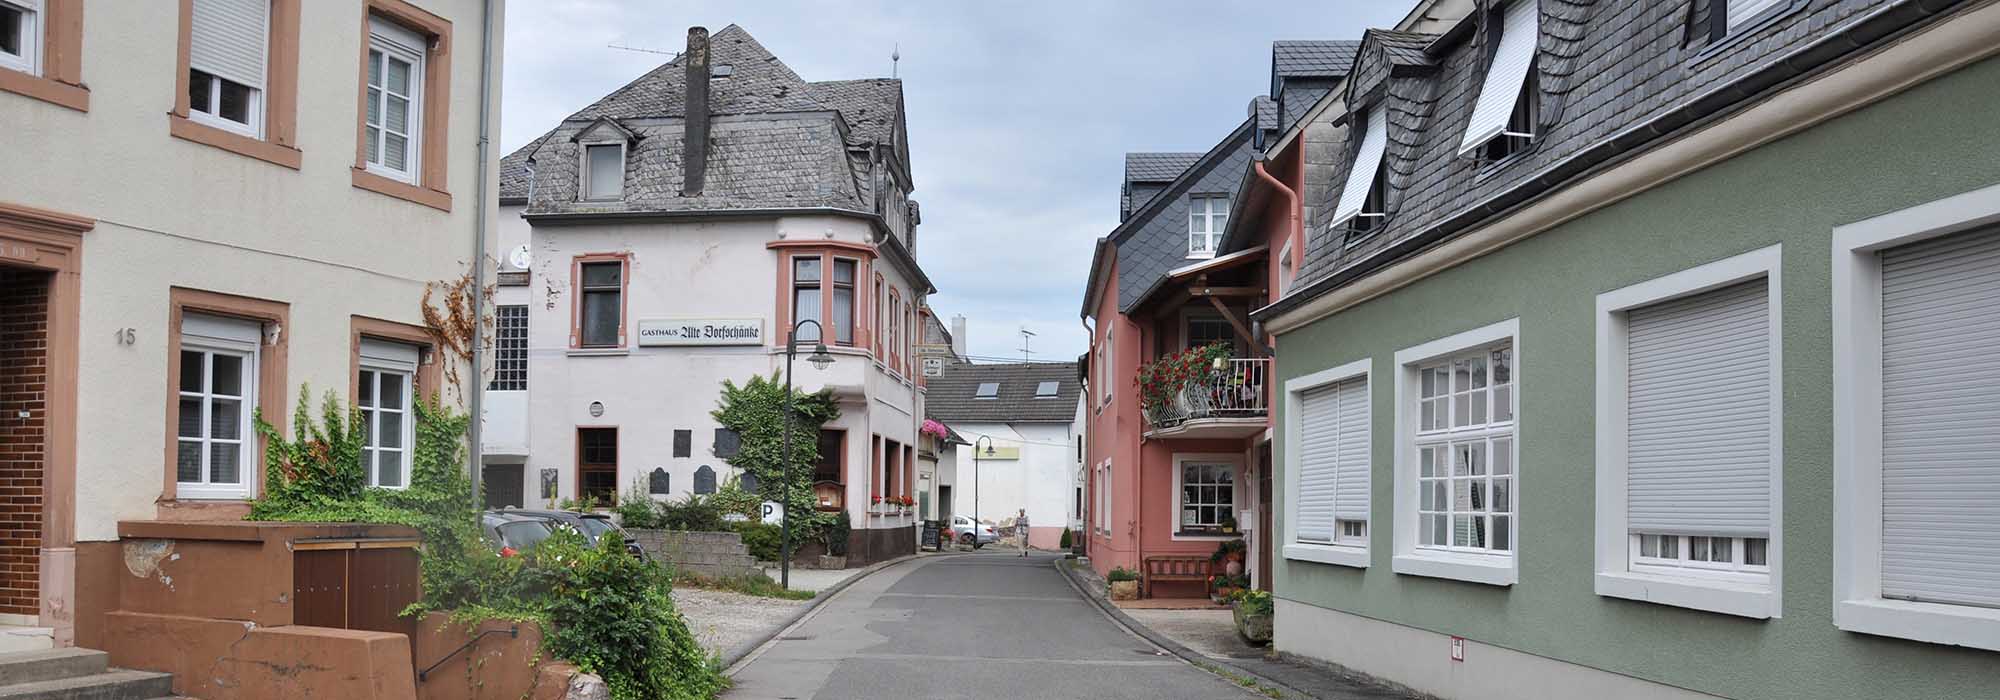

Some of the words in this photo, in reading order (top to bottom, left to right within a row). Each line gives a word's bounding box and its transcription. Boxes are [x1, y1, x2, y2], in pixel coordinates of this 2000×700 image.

[114, 327, 136, 345] 15
[641, 329, 678, 337] GASTHAUS
[680, 326, 701, 338] Alte
[703, 325, 759, 340] Dorfschänke
[763, 504, 773, 518] P
